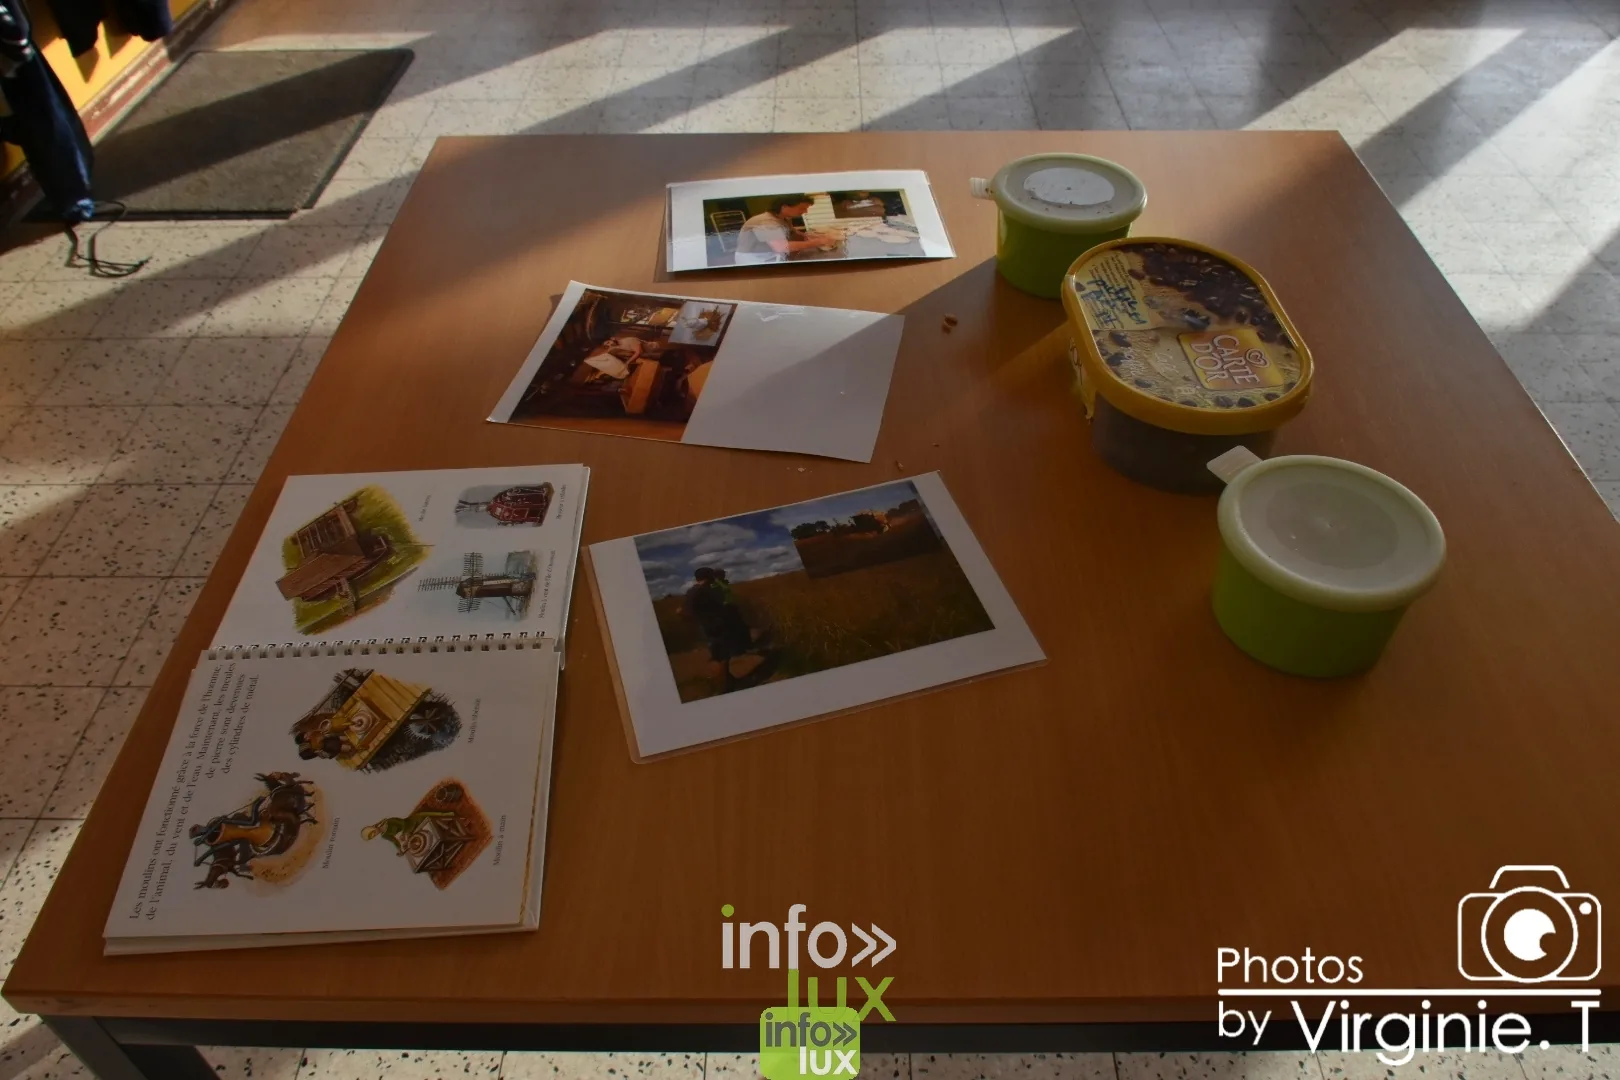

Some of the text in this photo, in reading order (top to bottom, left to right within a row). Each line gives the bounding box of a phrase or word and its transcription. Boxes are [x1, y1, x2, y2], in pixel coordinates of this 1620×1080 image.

[1190, 343, 1229, 382] D'OR
[1213, 335, 1260, 384] CARTE
[189, 717, 204, 738] force
[196, 703, 208, 715] de
[205, 673, 246, 778] de pierre sont devenues
[222, 674, 260, 774] des cylindres de métal.
[184, 740, 196, 749] la
[174, 759, 190, 783] grâce
[146, 662, 236, 920] de l'animal, du vent et de l'eau. Maintenant, les meules
[155, 786, 180, 836] fonctionné
[151, 839, 165, 856] ont
[321, 817, 340, 869] Moulin romain
[493, 841, 504, 865] Moulin
[137, 858, 157, 899] moulins
[129, 902, 143, 919] Les
